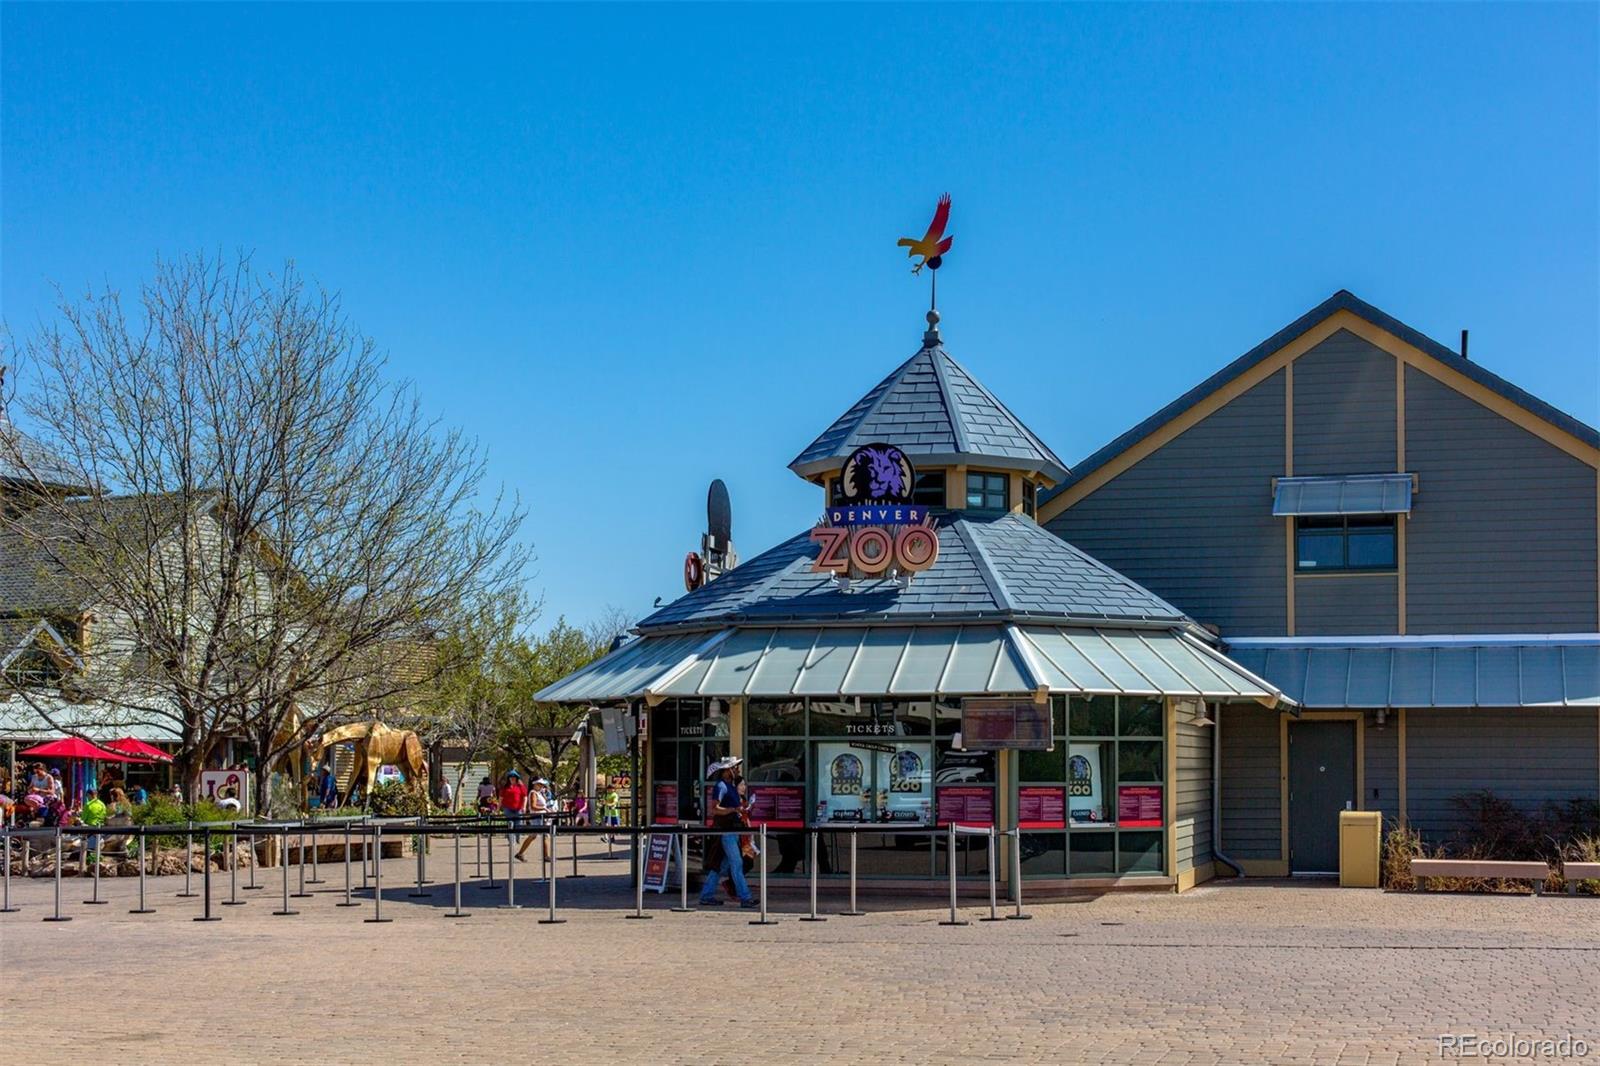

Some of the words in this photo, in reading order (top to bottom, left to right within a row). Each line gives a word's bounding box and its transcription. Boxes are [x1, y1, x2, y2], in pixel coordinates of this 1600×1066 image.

[833, 509, 918, 522] DENVER
[811, 526, 940, 573] ZOO
[846, 724, 895, 734] TICKETS
[833, 783, 861, 794] ZOO
